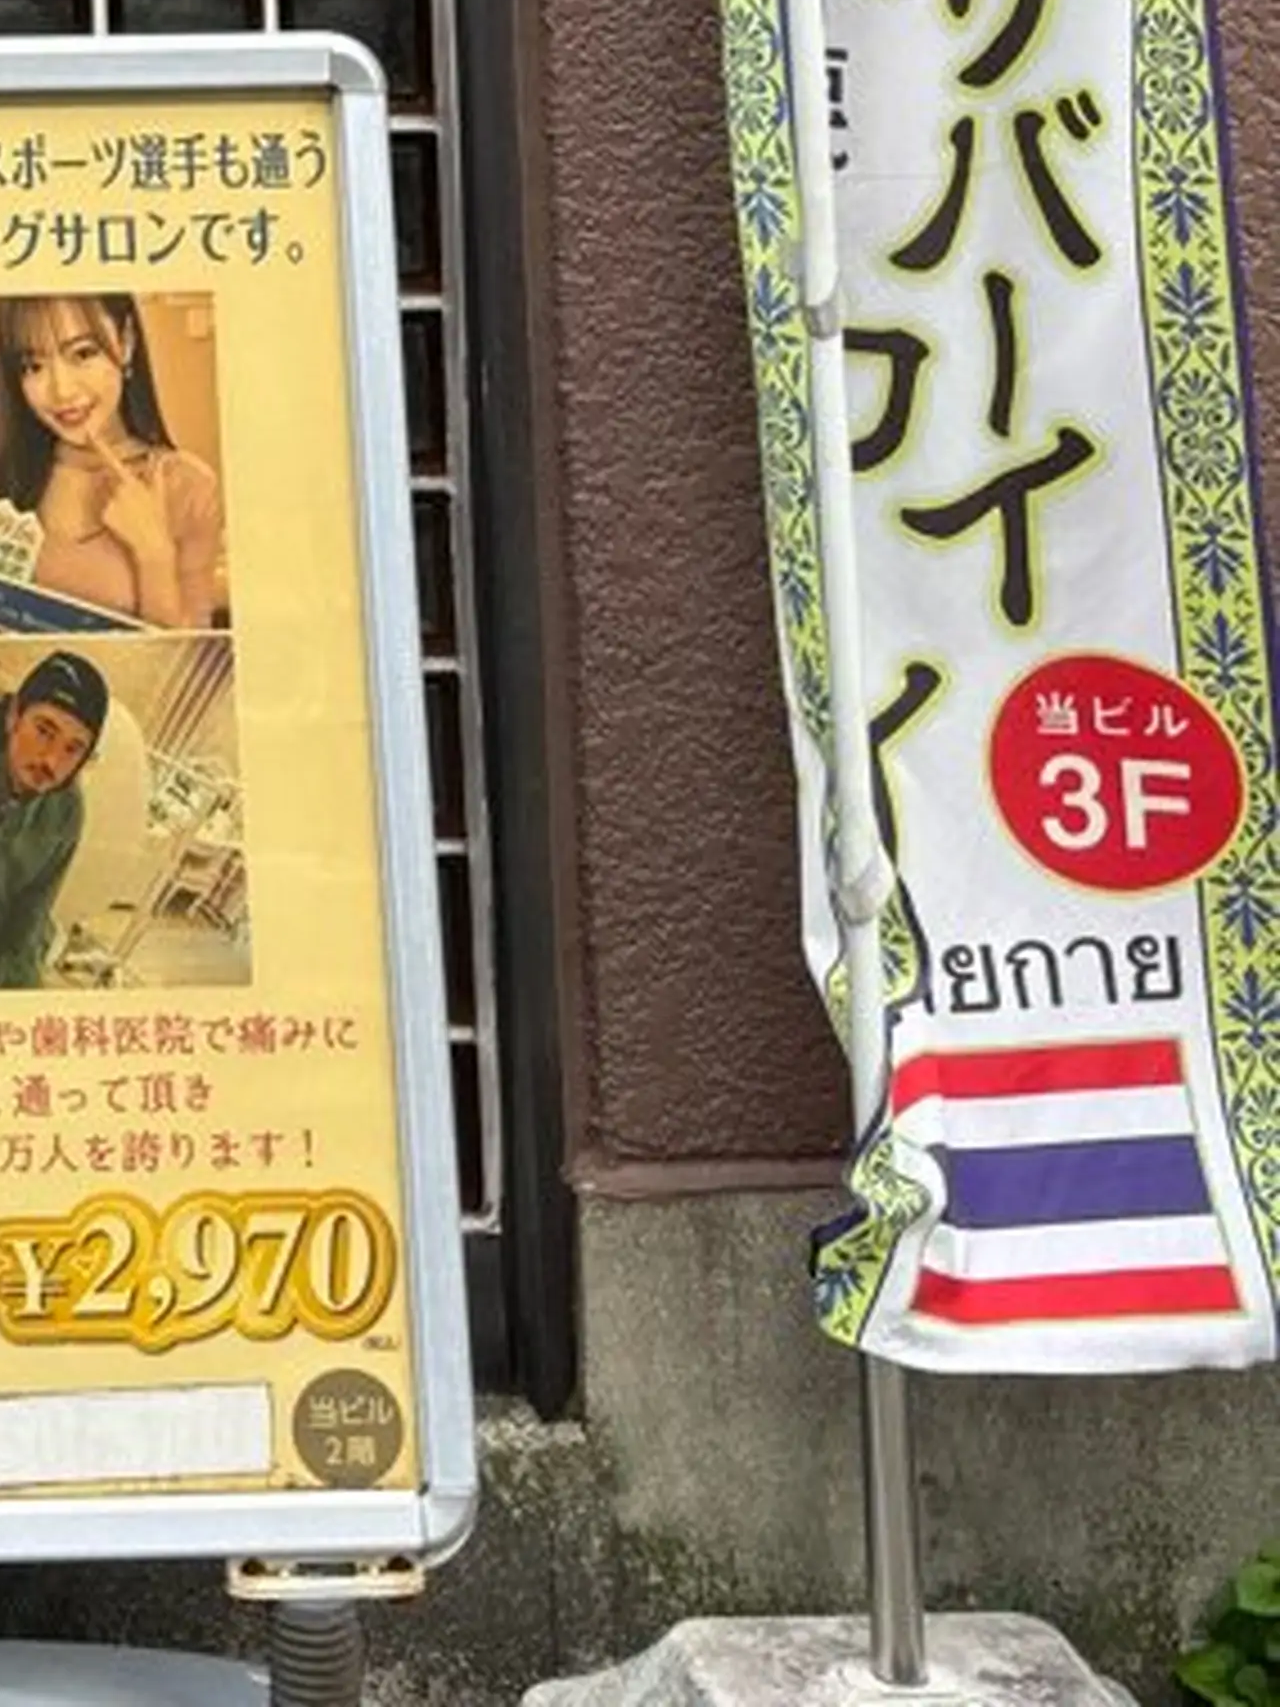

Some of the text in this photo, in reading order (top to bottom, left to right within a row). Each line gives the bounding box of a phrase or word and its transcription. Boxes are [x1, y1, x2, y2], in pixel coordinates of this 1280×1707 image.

[1036, 691, 1191, 738] 当ビル
[1040, 753, 1192, 851] 3F
[922, 934, 1183, 1015] ยกาย
[0, 1212, 378, 1324] ¥2,970
[308, 1394, 394, 1429] 当ビル
